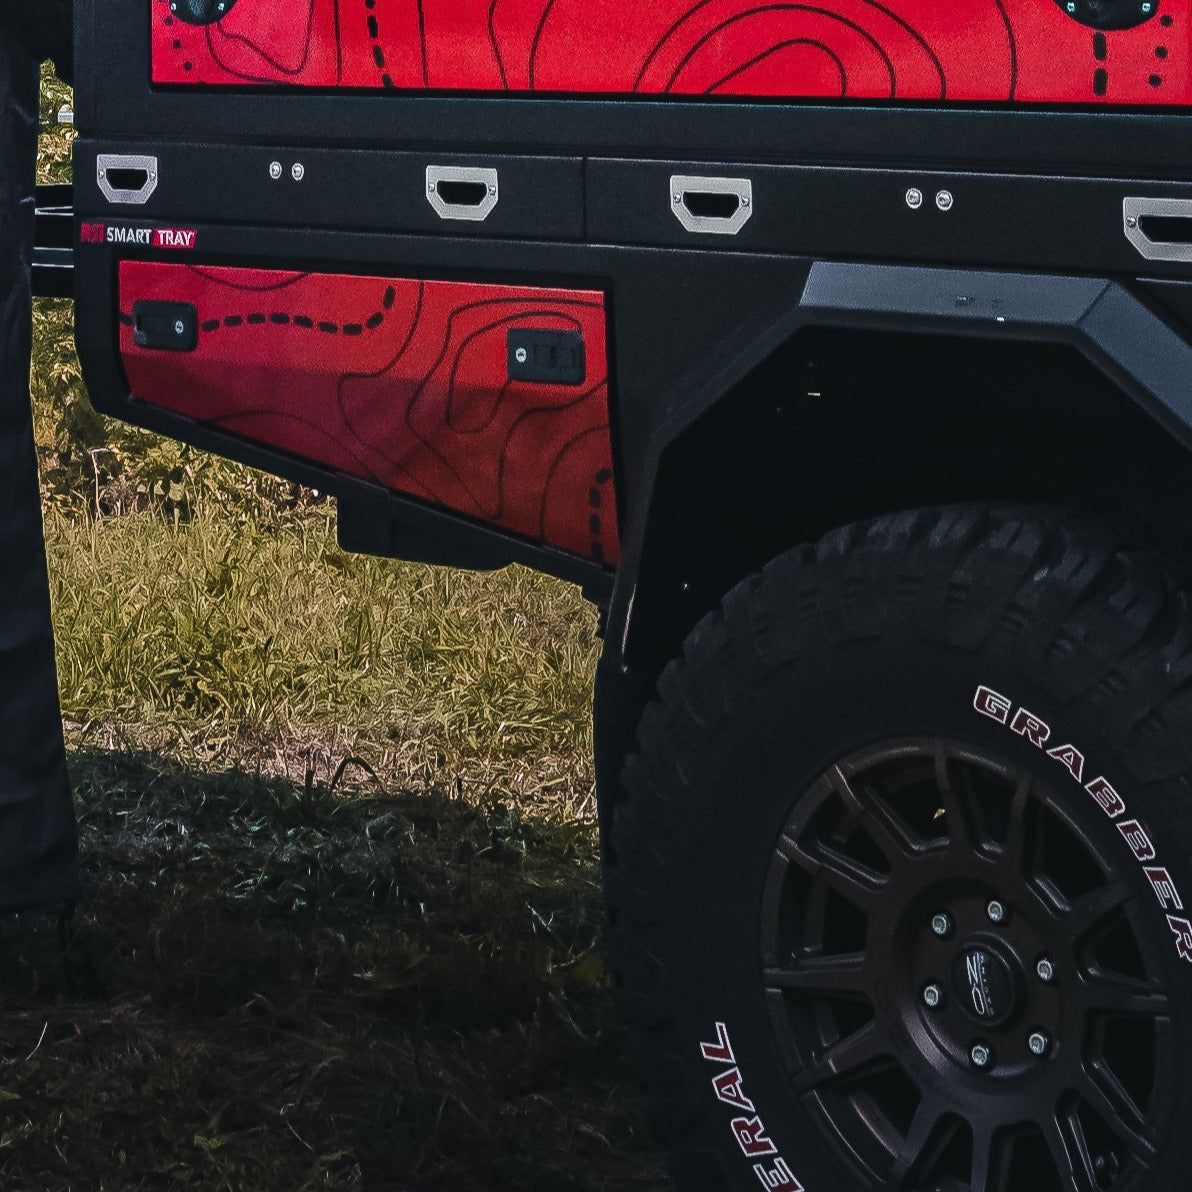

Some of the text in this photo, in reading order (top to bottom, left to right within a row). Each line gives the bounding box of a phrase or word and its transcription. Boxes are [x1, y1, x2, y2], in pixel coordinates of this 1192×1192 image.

[107, 227, 152, 244] SMART
[157, 228, 195, 246] TRAY
[973, 685, 1192, 963] GRABBER
